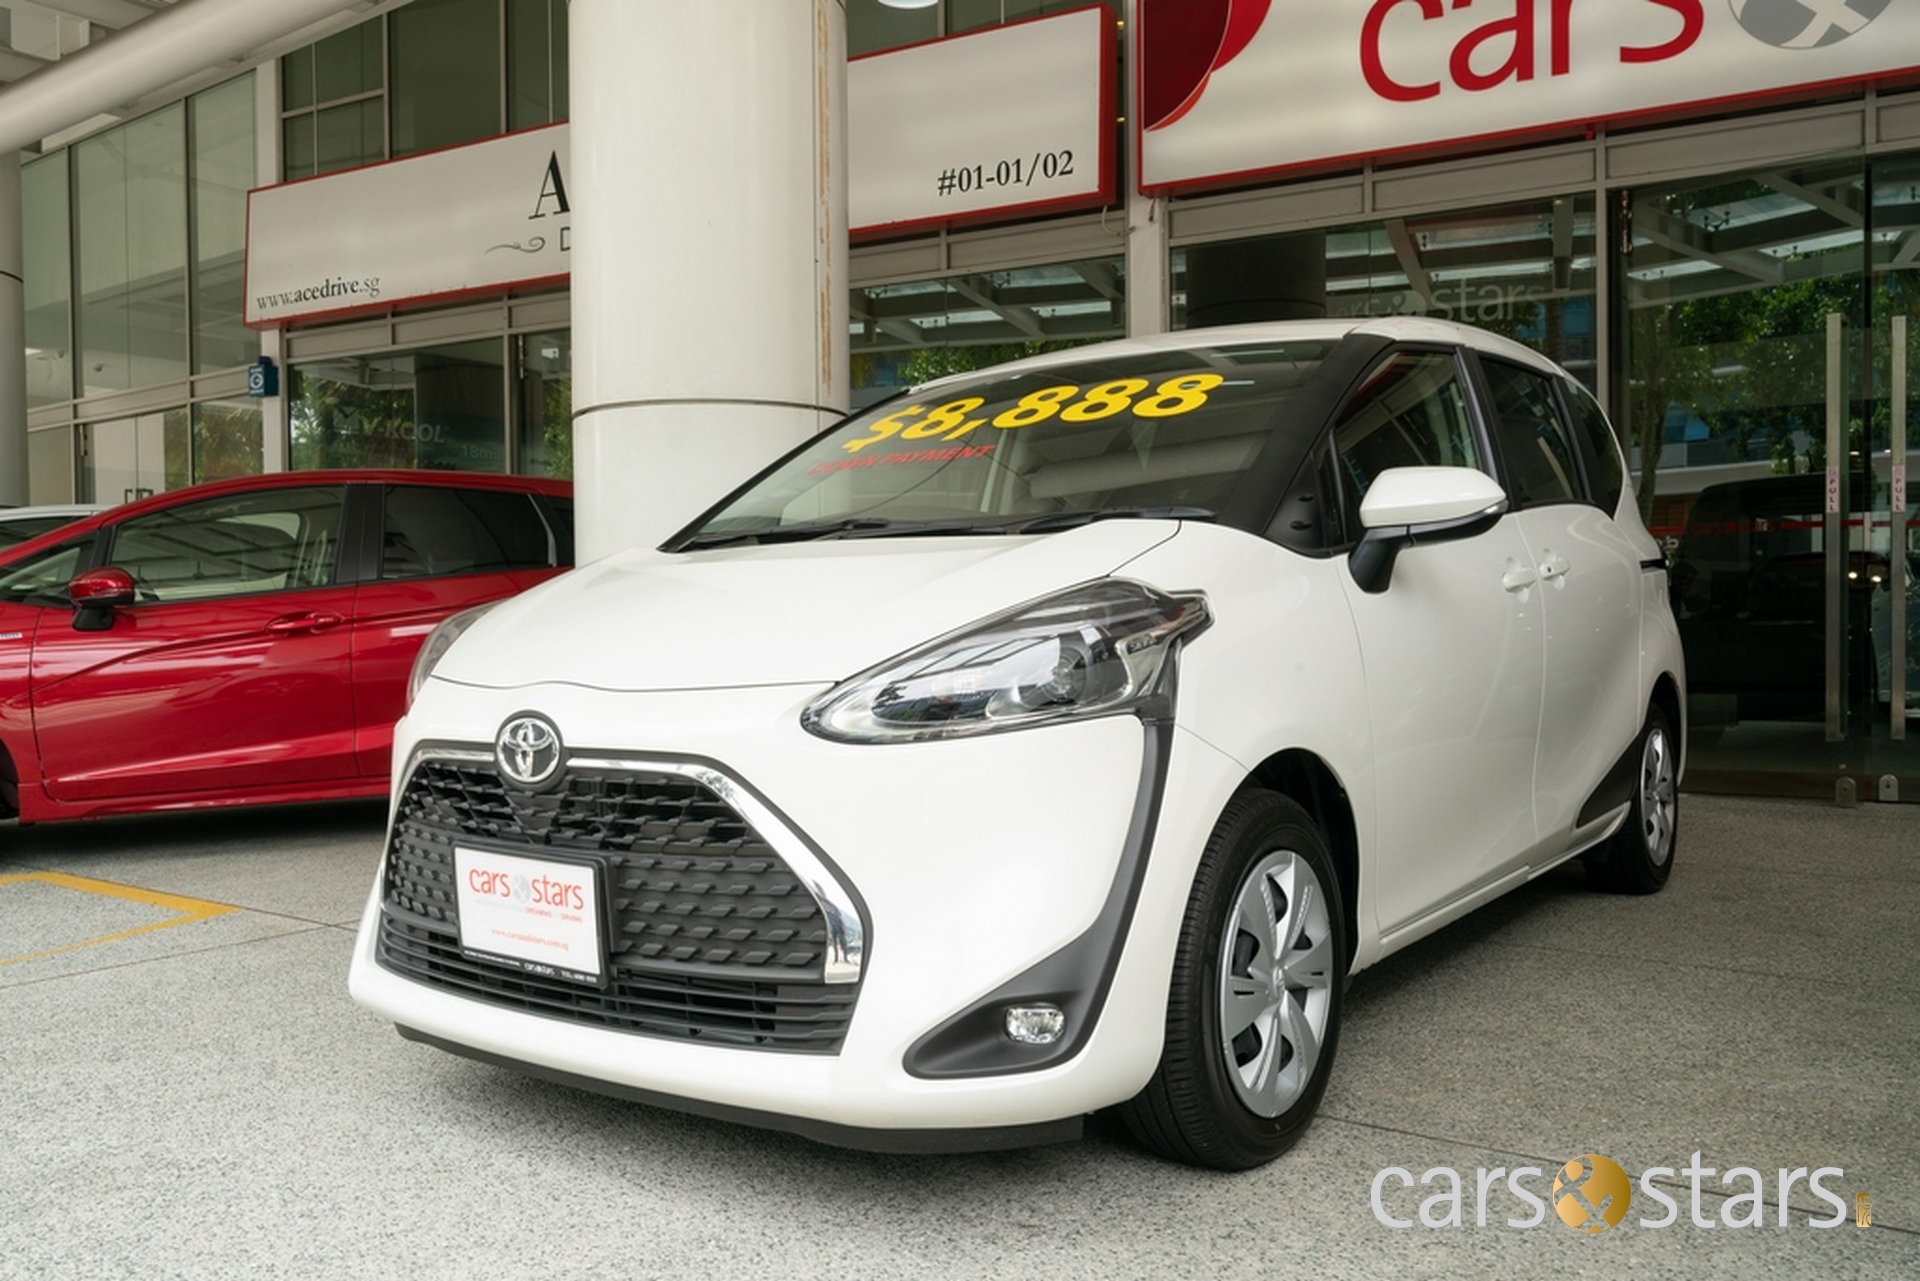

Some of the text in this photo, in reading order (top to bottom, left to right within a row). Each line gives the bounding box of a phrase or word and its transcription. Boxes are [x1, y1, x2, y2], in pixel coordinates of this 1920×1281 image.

[937, 149, 1074, 197] #01-01/02
[256, 276, 380, 310] www.acedrive.sg
[841, 373, 1224, 454] $8,888
[880, 444, 997, 466] PAYMENT
[1828, 478, 1837, 511] PULL
[1894, 478, 1903, 511] PULL
[469, 868, 511, 898] cars
[531, 875, 585, 910] stars
